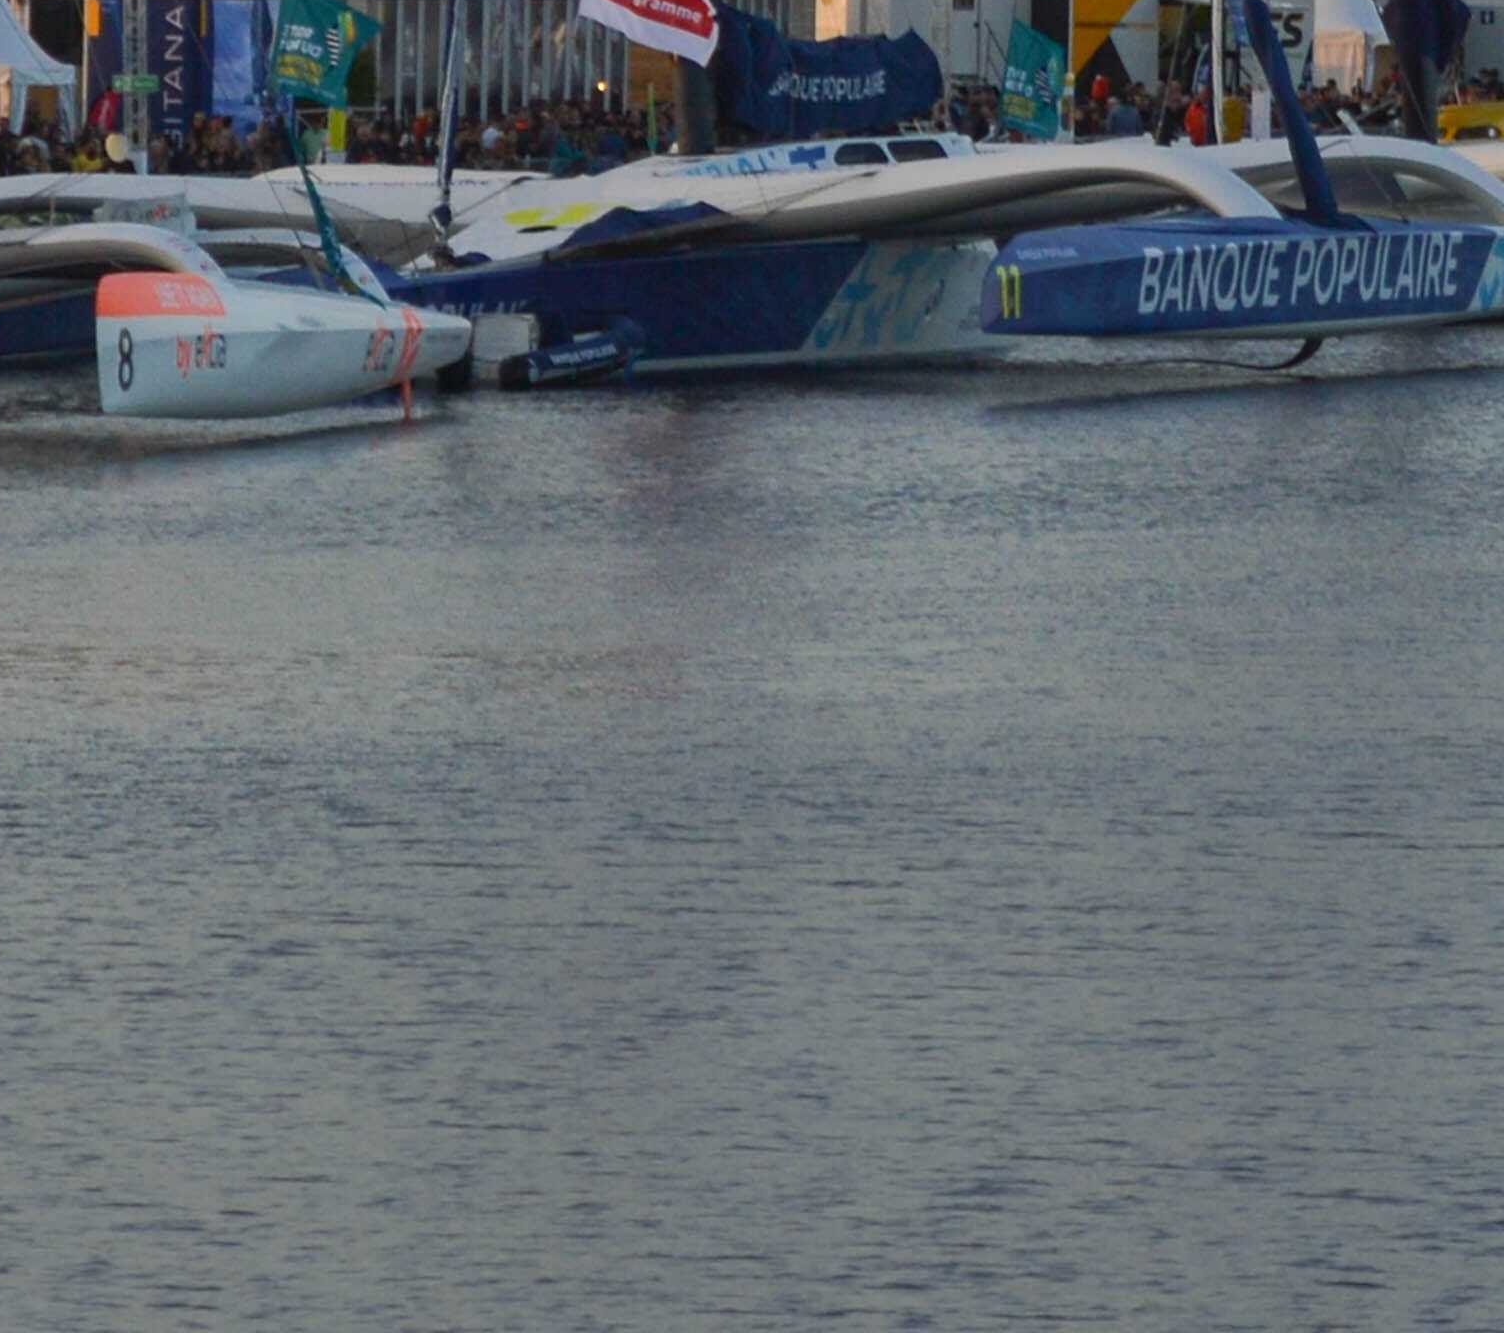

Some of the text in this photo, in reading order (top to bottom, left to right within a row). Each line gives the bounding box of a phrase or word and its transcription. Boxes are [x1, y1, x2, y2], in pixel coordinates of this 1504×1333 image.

[995, 264, 1023, 319] 11
[1137, 230, 1463, 315] BANQUE POPULAIRE
[117, 325, 135, 392] 8
